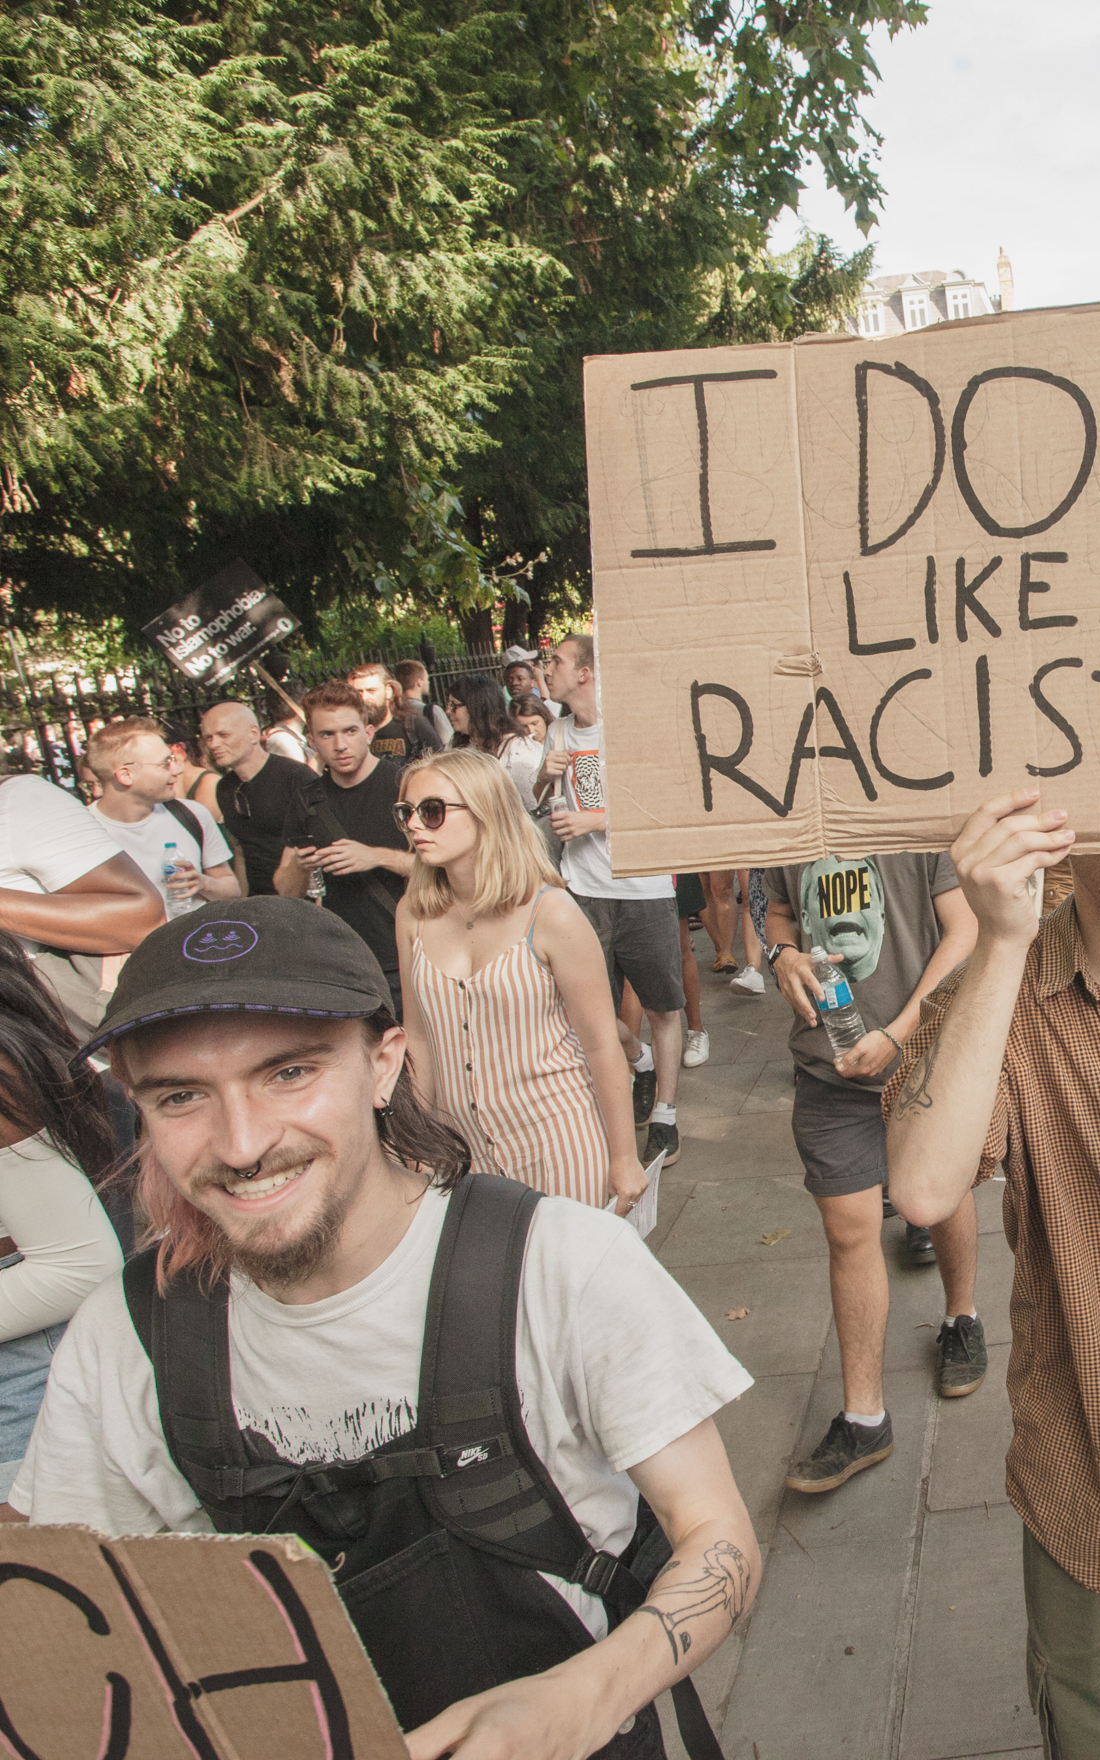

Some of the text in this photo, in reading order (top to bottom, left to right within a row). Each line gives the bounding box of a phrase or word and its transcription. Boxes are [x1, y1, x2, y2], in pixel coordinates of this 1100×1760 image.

[630, 368, 778, 558] I
[168, 588, 267, 660] Islamophobia.
[843, 551, 1078, 655] LIKE
[156, 614, 202, 648] No to
[184, 620, 257, 677] No to war.
[818, 866, 870, 918] NOPE
[461, 1446, 482, 1459] NIKE
[477, 1452, 488, 1462] SB
